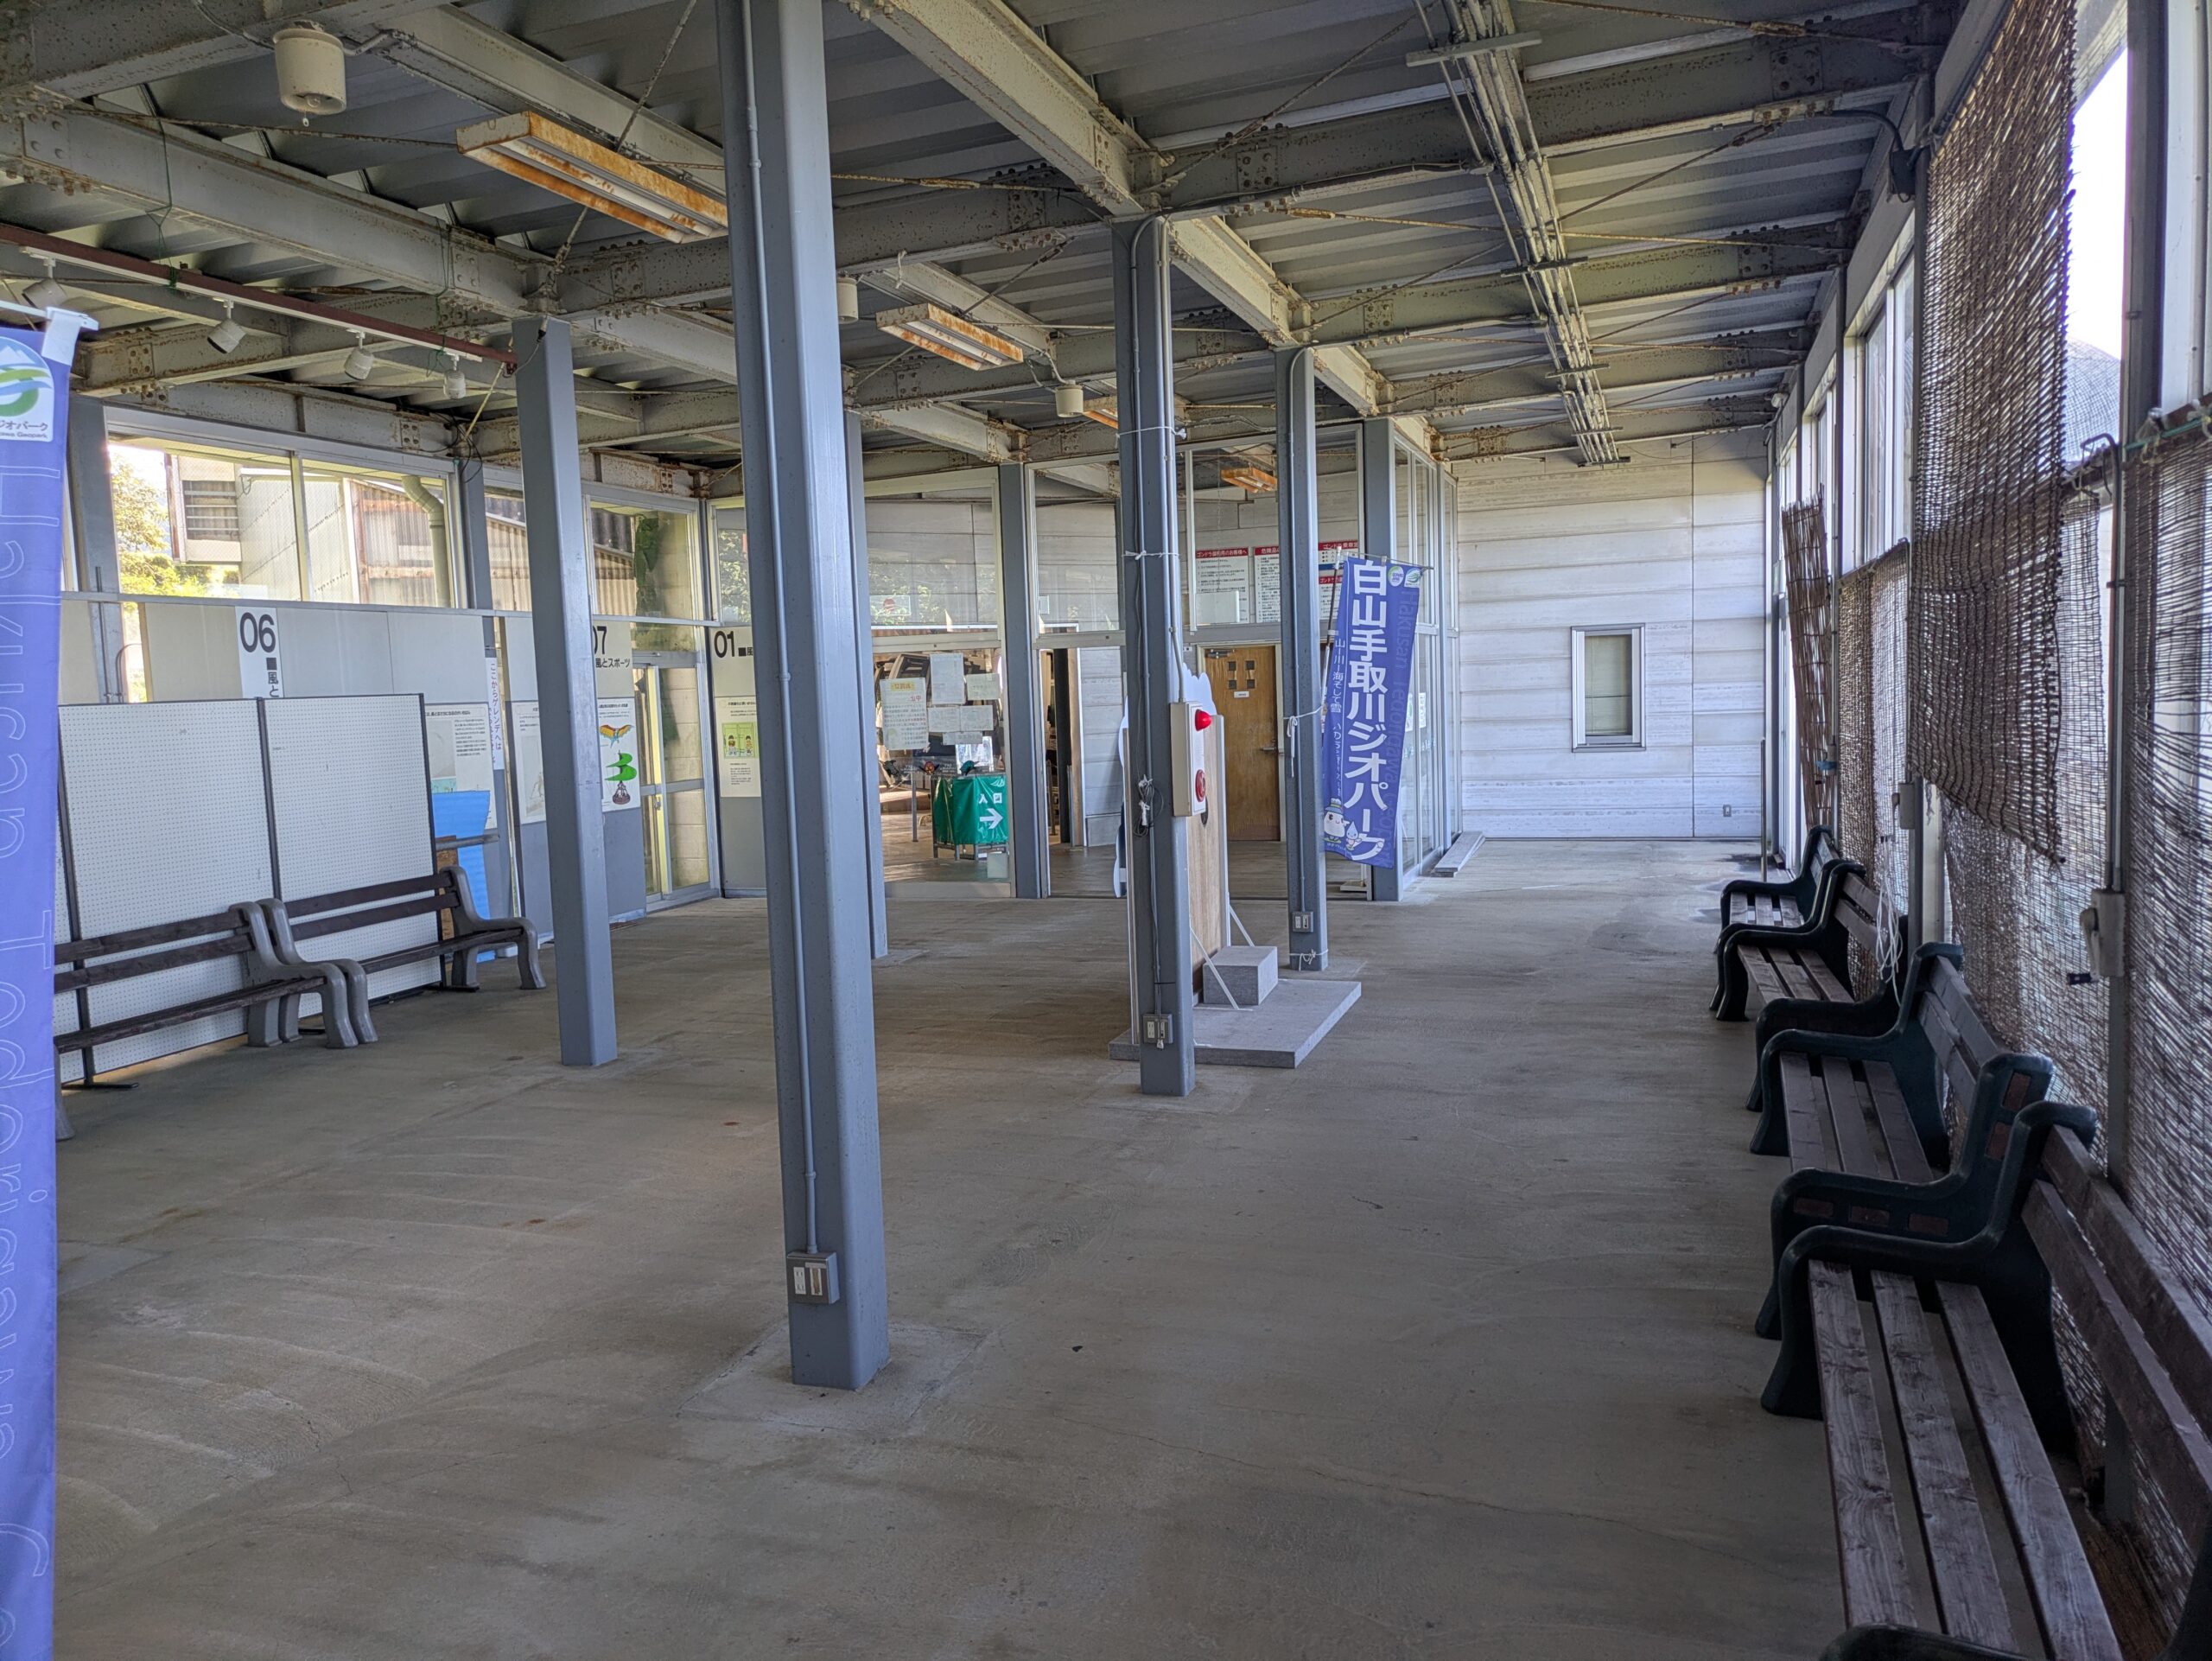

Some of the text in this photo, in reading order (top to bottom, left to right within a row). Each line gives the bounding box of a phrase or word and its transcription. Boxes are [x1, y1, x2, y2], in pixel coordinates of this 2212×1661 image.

[240, 612, 276, 652] 06
[714, 630, 735, 658] 01
[1344, 560, 1389, 861] 白山手取川ジオパーク
[978, 792, 1002, 805] 入口
